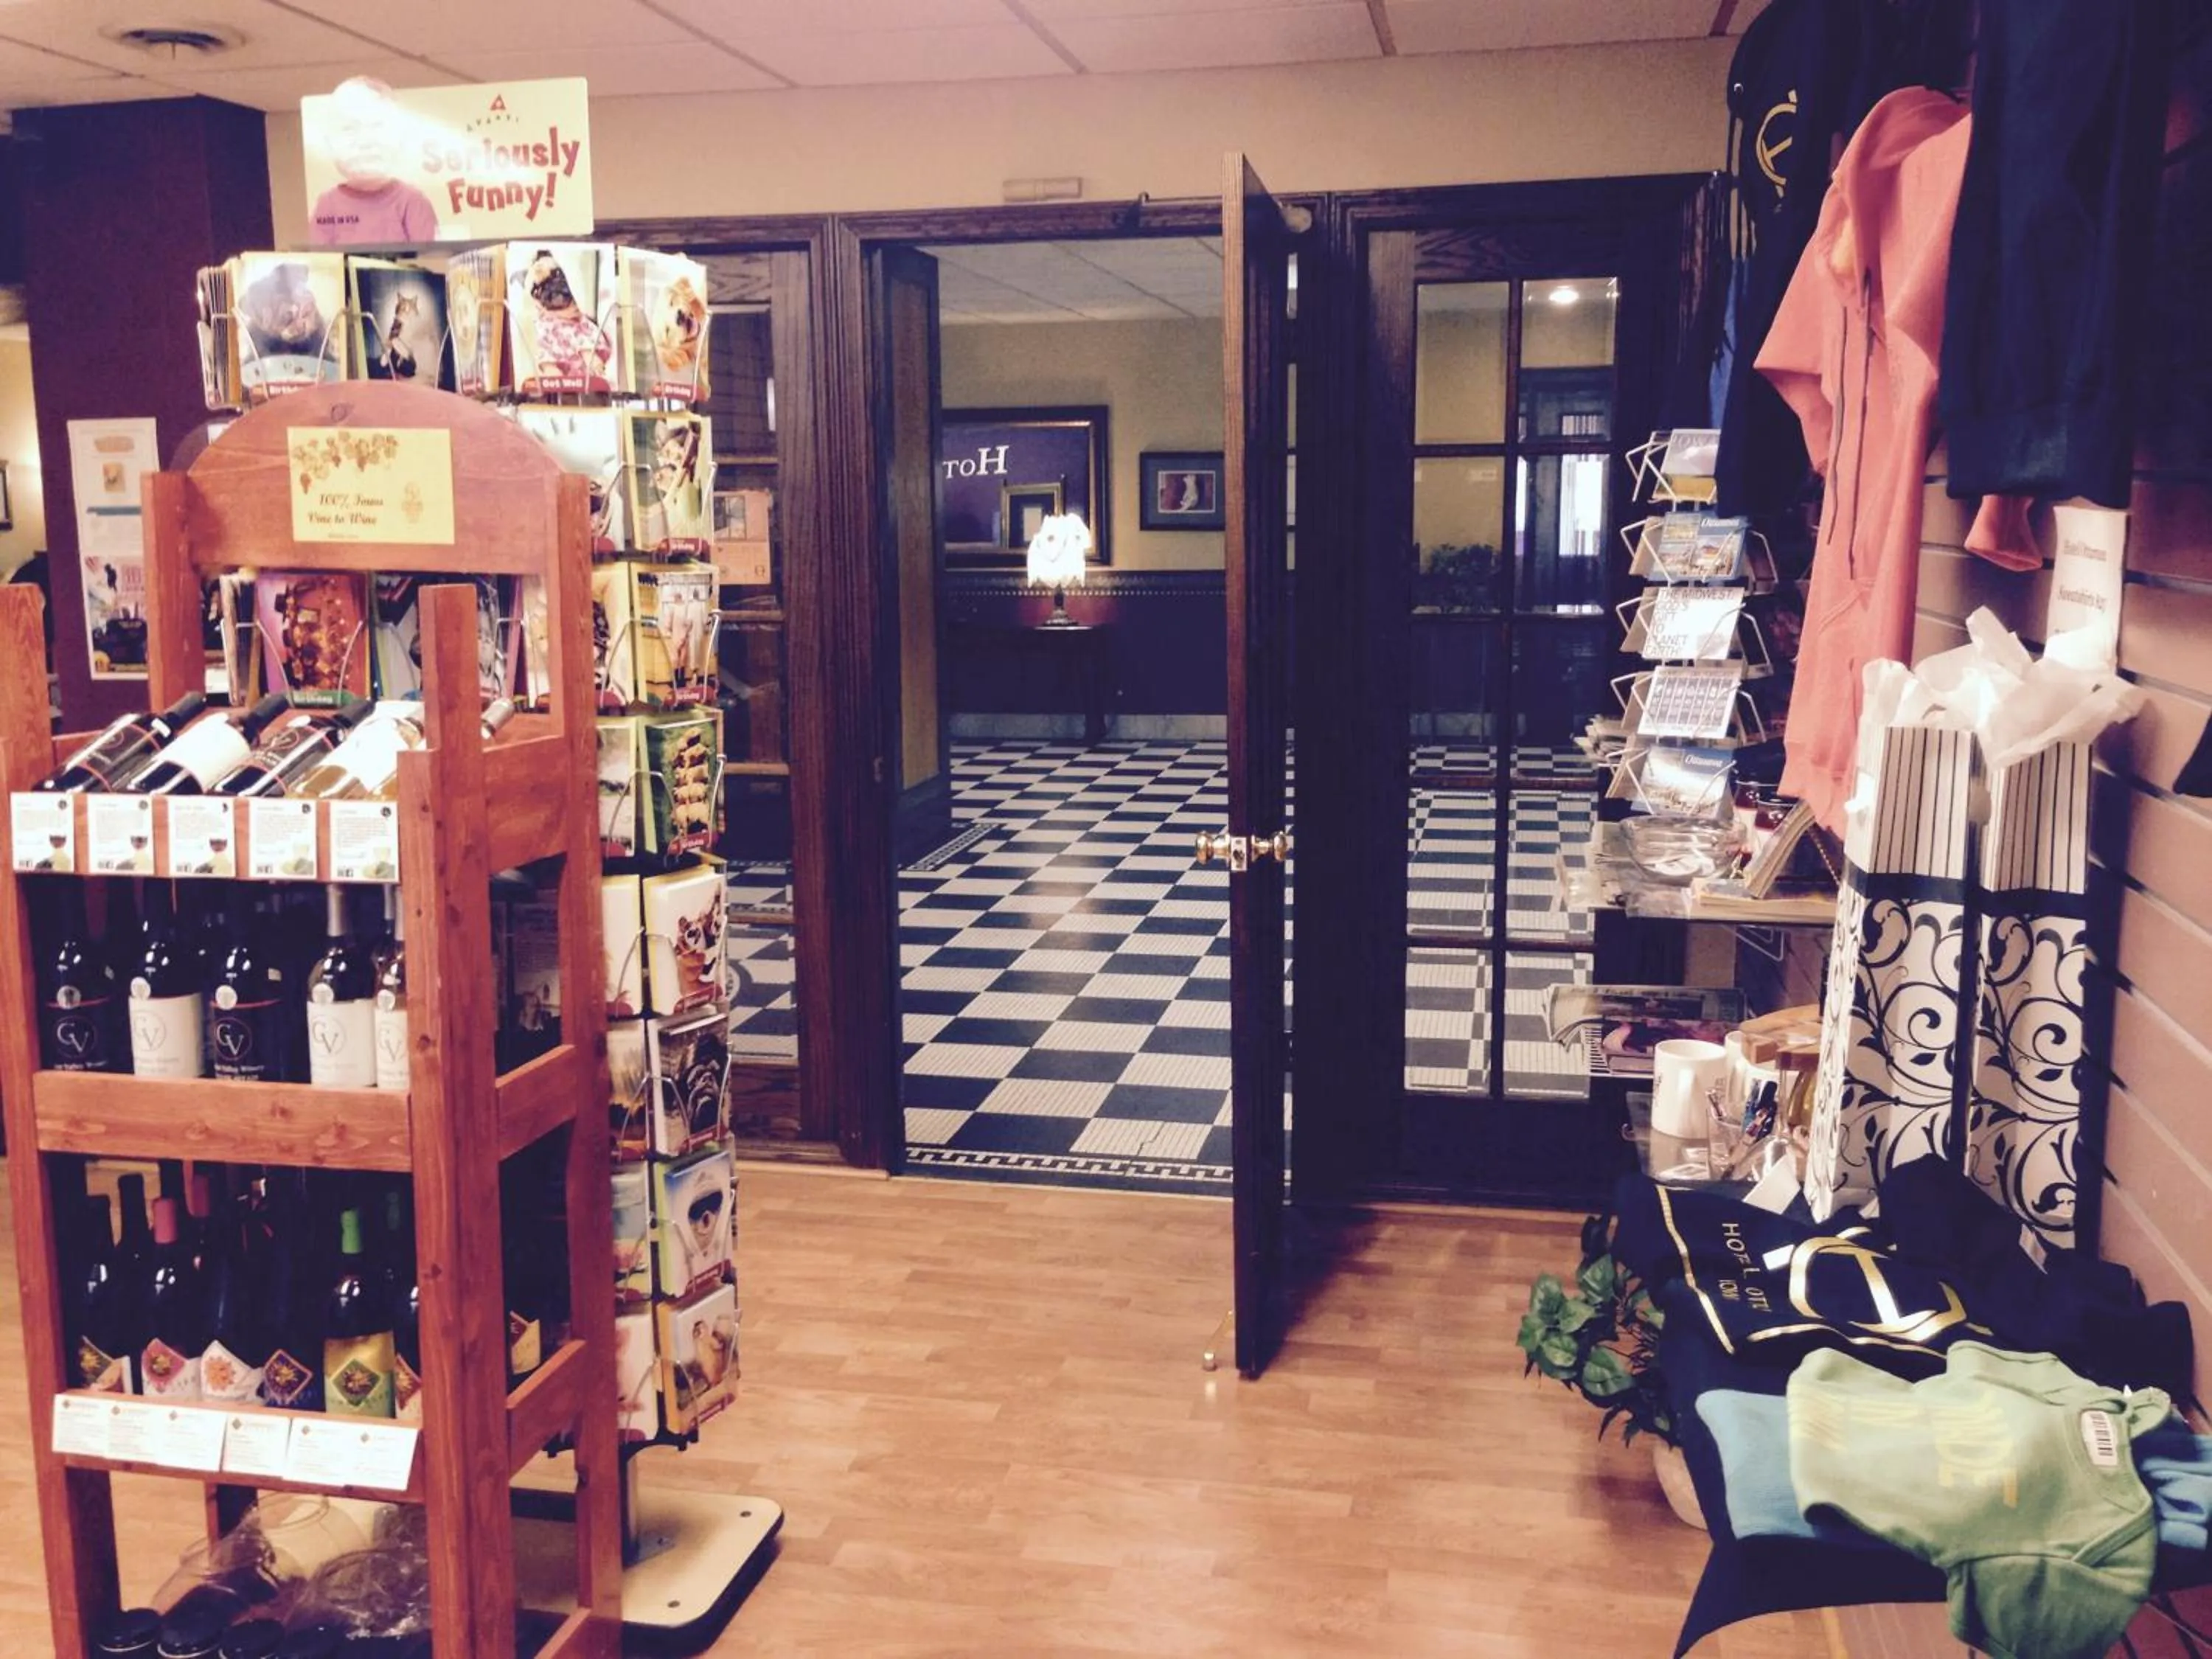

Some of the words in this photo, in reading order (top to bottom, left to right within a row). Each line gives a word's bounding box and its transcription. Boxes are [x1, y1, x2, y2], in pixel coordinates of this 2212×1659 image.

[422, 126, 580, 176] Seriously
[447, 172, 557, 220] Funny!
[307, 511, 332, 525] Vine
[334, 512, 345, 524] to
[349, 512, 378, 525] Wine
